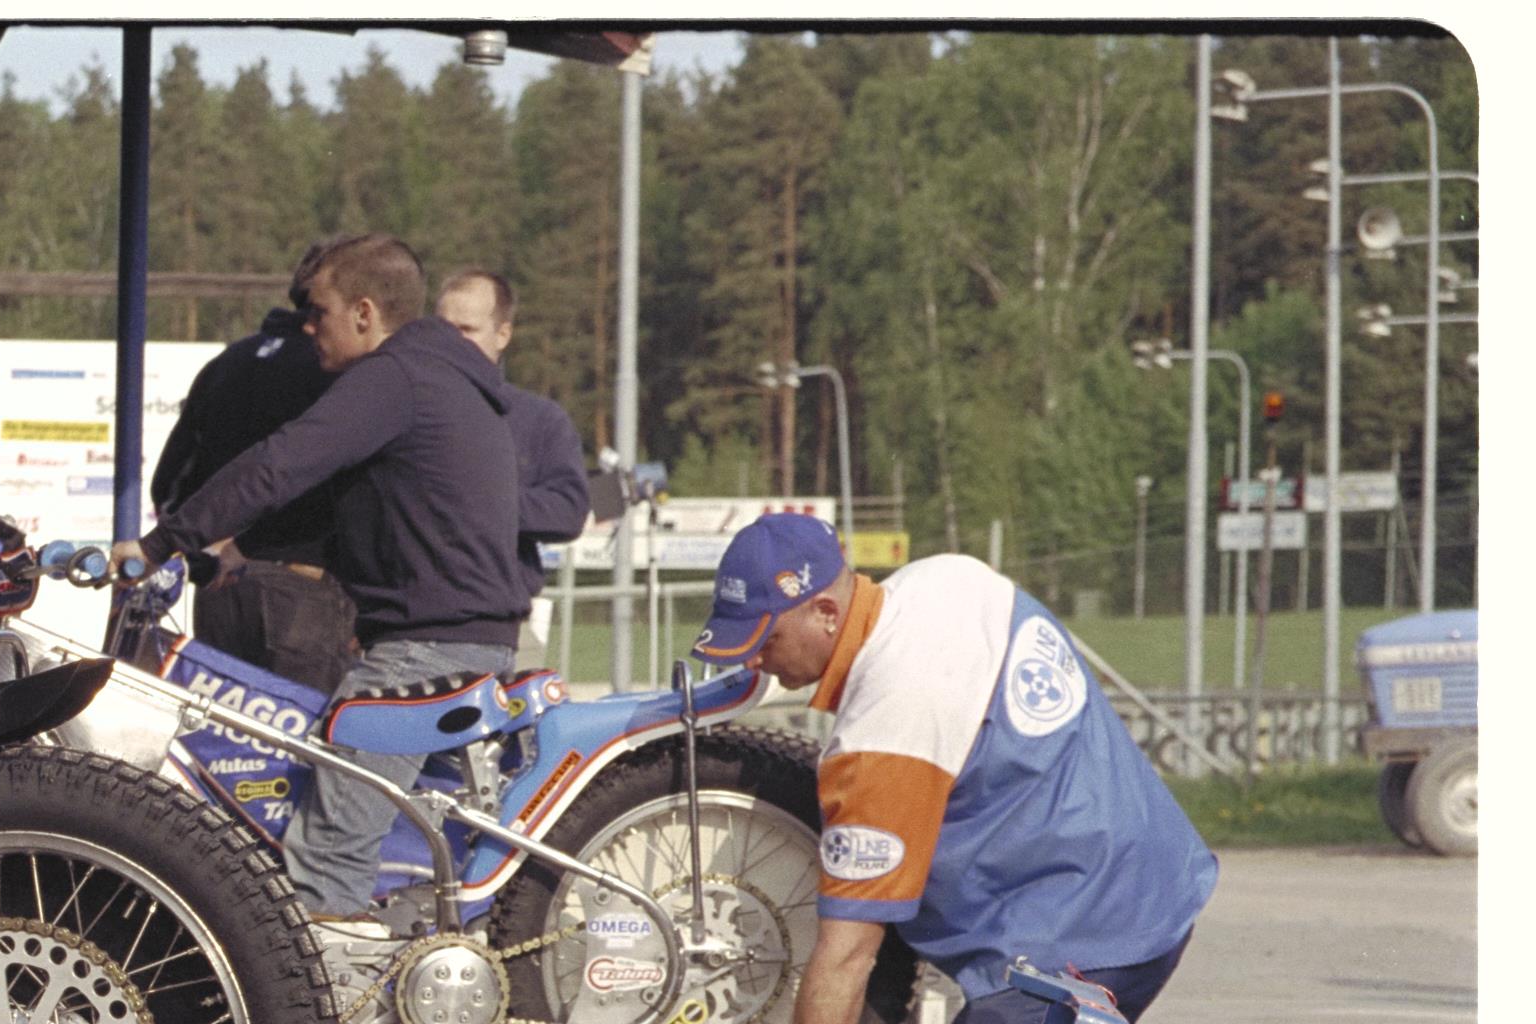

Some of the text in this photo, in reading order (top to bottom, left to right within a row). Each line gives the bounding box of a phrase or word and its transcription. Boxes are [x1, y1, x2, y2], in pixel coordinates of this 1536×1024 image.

[694, 629, 714, 653] 2
[1034, 625, 1057, 661] LNB
[187, 671, 307, 739] HAGO
[857, 839, 890, 854] LNB
[588, 920, 651, 933] OMEGA
